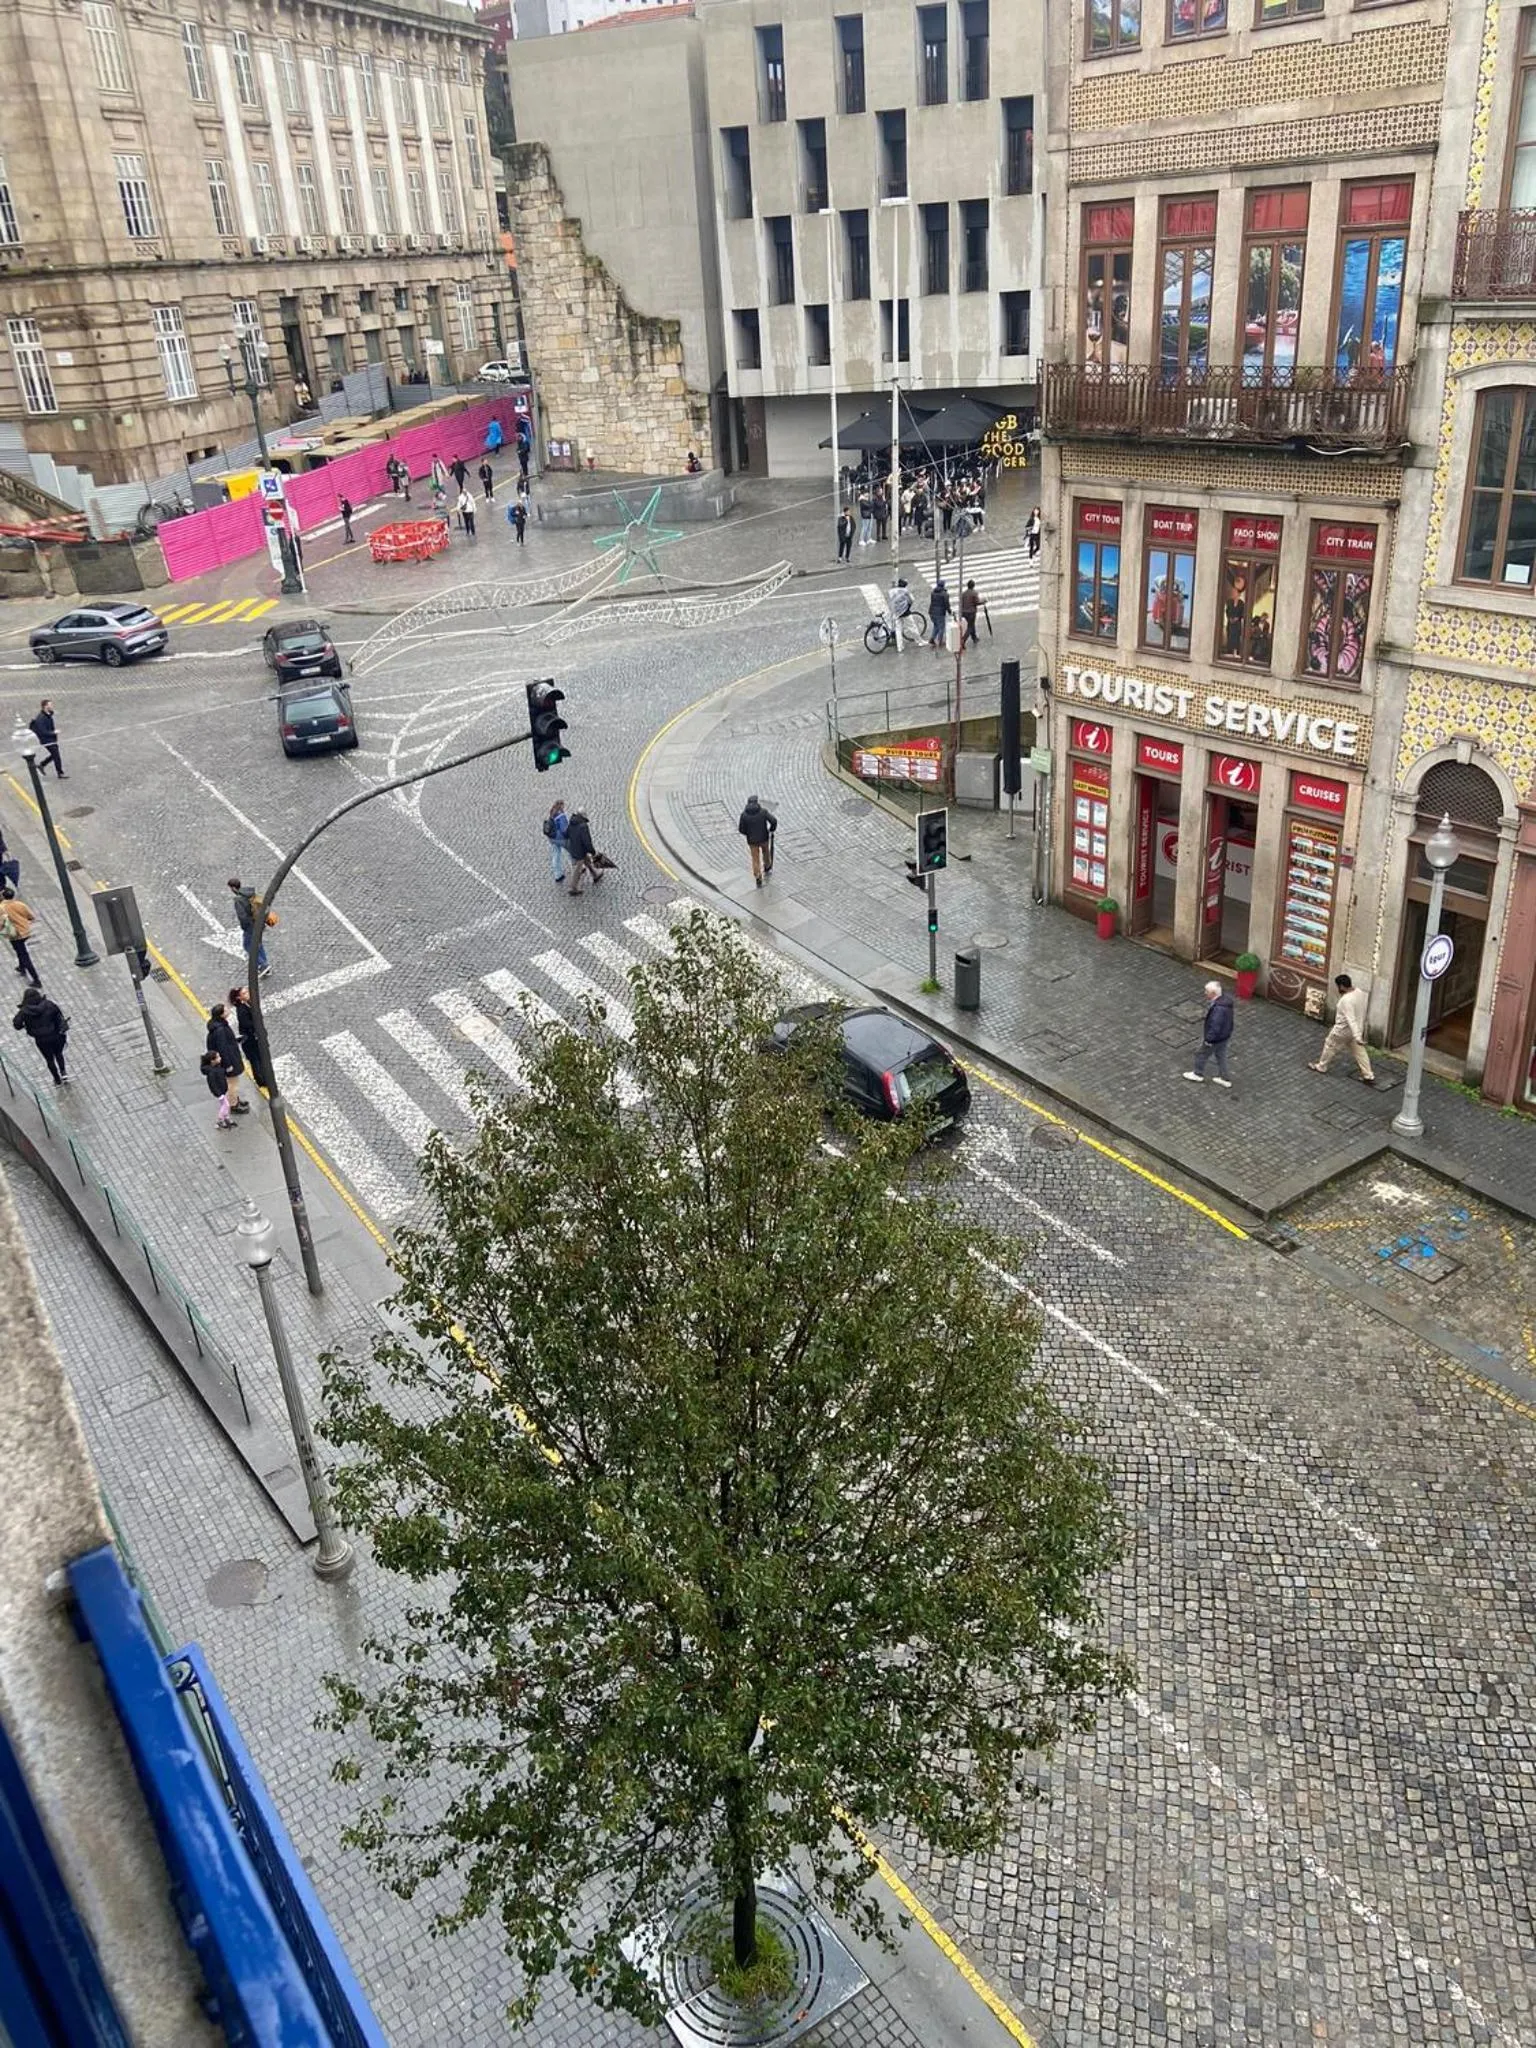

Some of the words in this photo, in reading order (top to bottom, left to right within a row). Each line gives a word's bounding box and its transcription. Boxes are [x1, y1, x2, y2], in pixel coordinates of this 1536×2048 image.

[981, 443, 1025, 458] GOOD
[1085, 513, 1100, 523] CITY
[1102, 514, 1120, 525] TOUR
[1153, 520, 1173, 530] BOAT
[1175, 522, 1193, 532] TRIP
[1233, 528, 1254, 538] FADO
[1256, 530, 1279, 541] SHOW
[1326, 537, 1345, 547] CITY
[1347, 539, 1373, 550] TRAIN
[1062, 666, 1194, 719] TOURIST
[1204, 695, 1360, 756] SERVICE
[1144, 746, 1179, 764] TOURS
[1299, 785, 1341, 803] CRUISES
[1225, 861, 1251, 876] RIST
